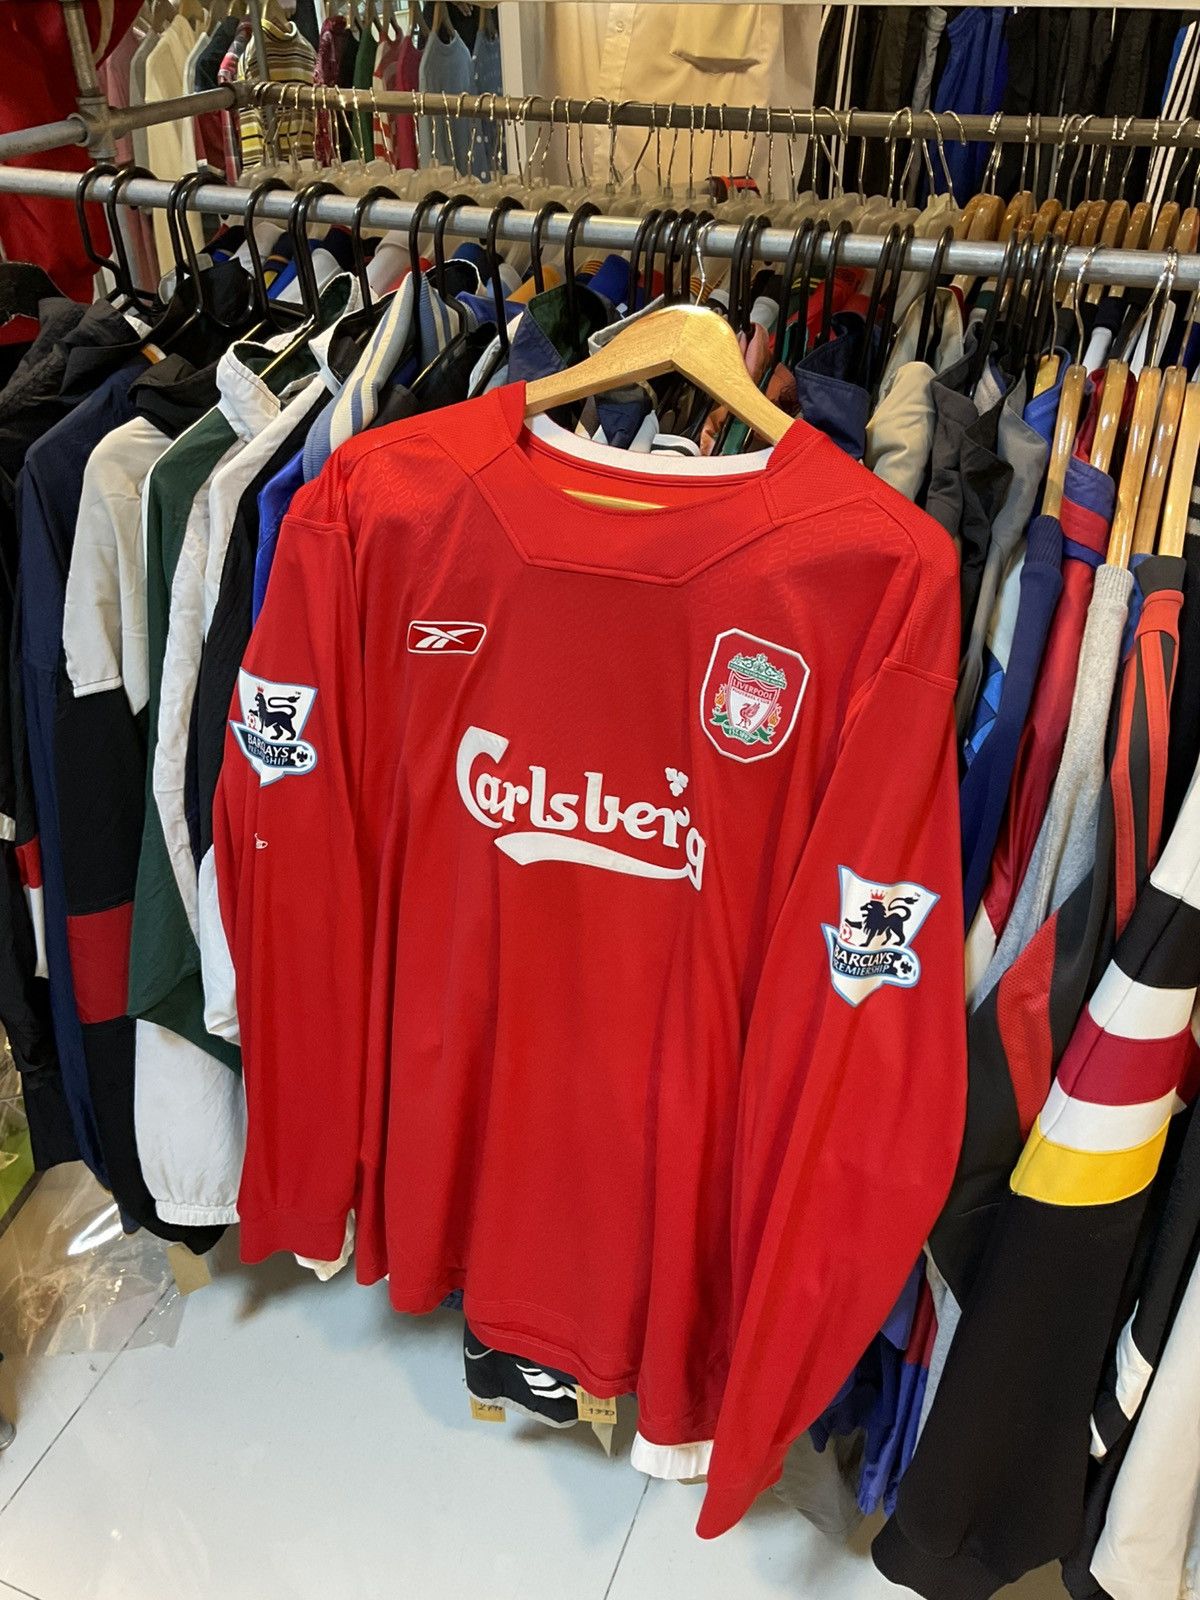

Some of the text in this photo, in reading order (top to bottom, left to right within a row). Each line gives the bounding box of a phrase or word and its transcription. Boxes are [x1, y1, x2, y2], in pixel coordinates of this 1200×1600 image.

[733, 679, 773, 700] LIVERPOOL
[456, 726, 706, 891] Carlsberg
[833, 944, 894, 967] BARCLAYS
